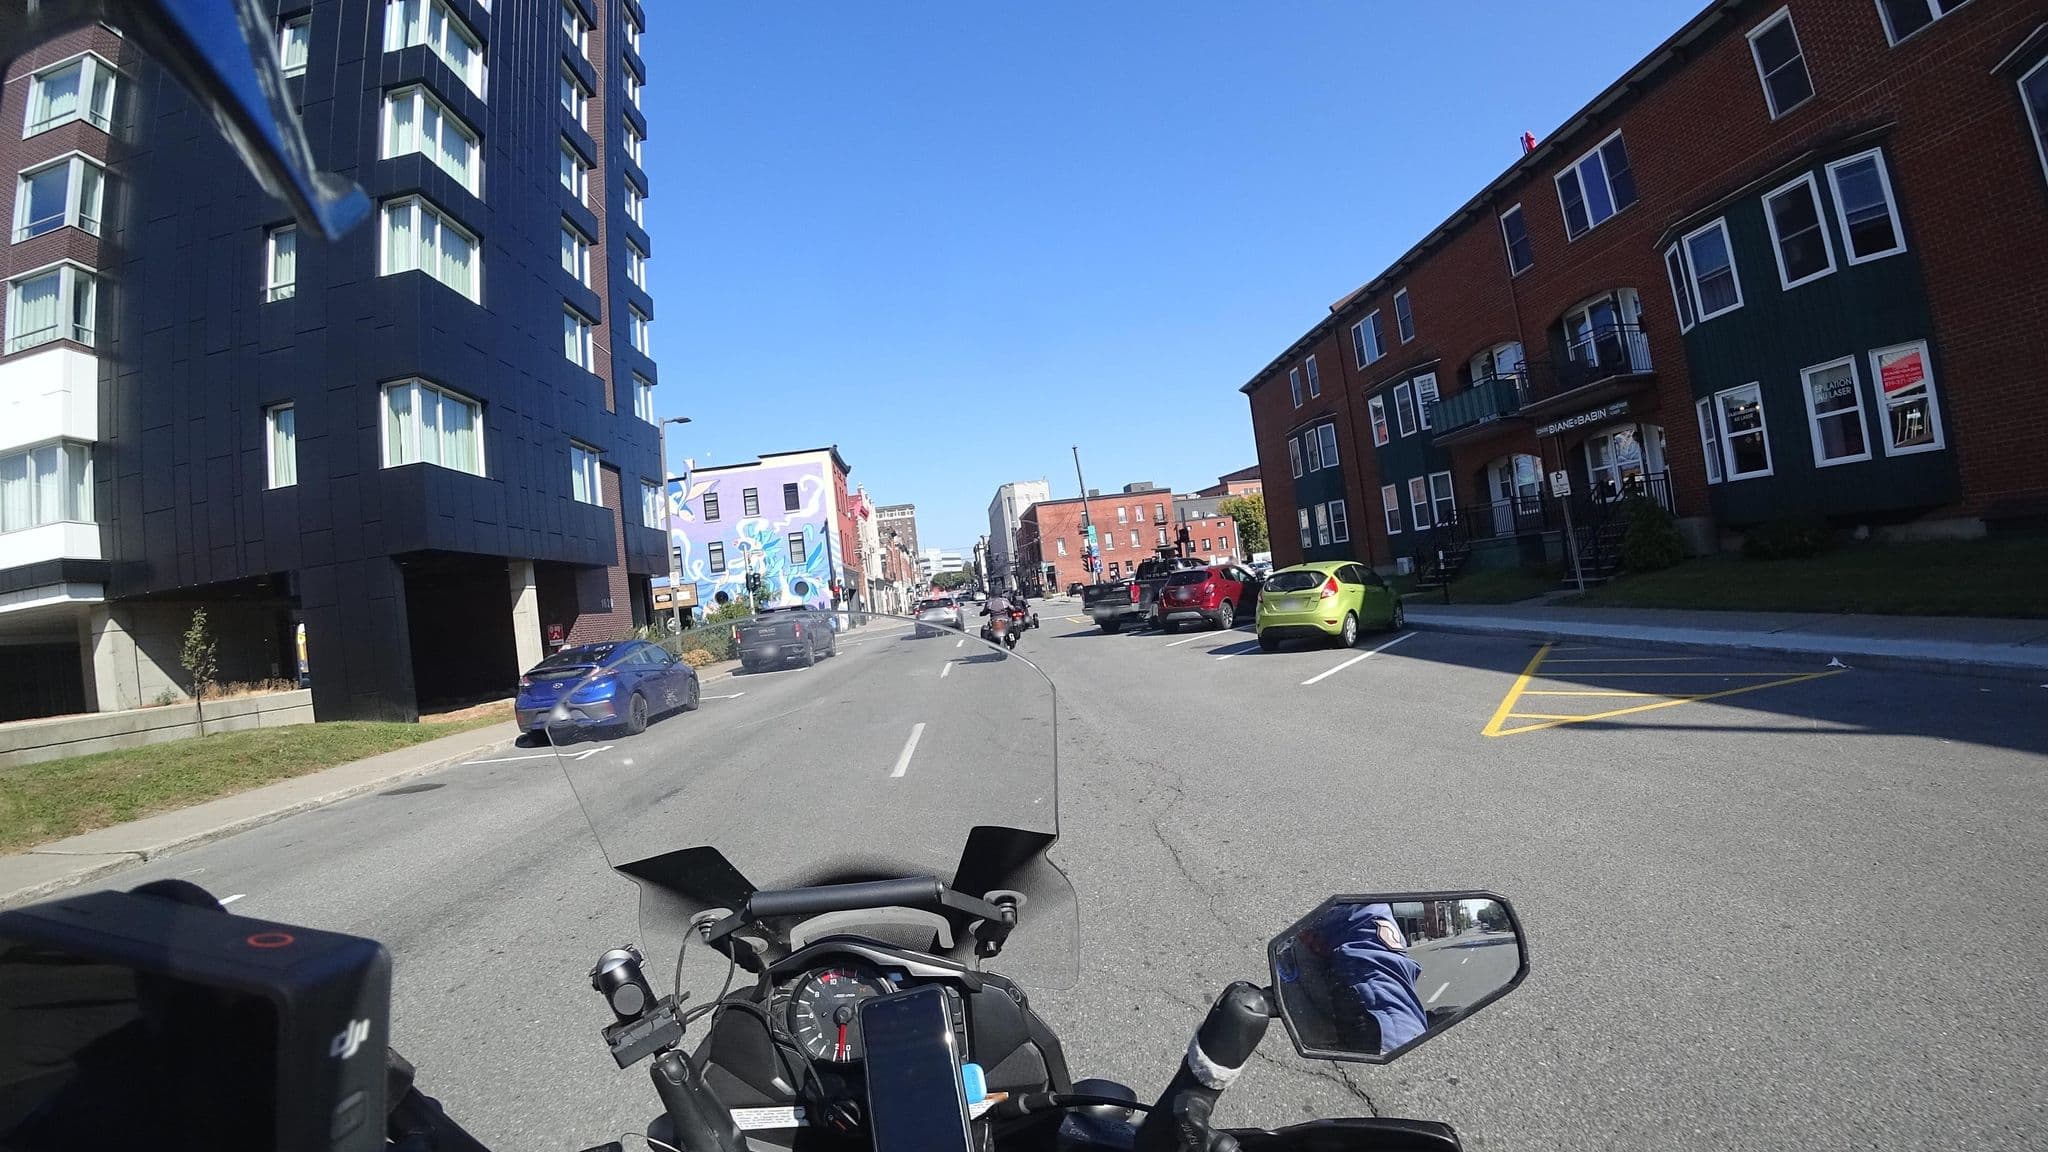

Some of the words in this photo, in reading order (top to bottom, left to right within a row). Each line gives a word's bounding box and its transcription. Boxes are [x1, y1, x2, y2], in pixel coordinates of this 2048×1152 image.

[1829, 386, 1852, 398] LASER
[1548, 418, 1574, 434] DIANE
[1578, 409, 1607, 425] BABIN
